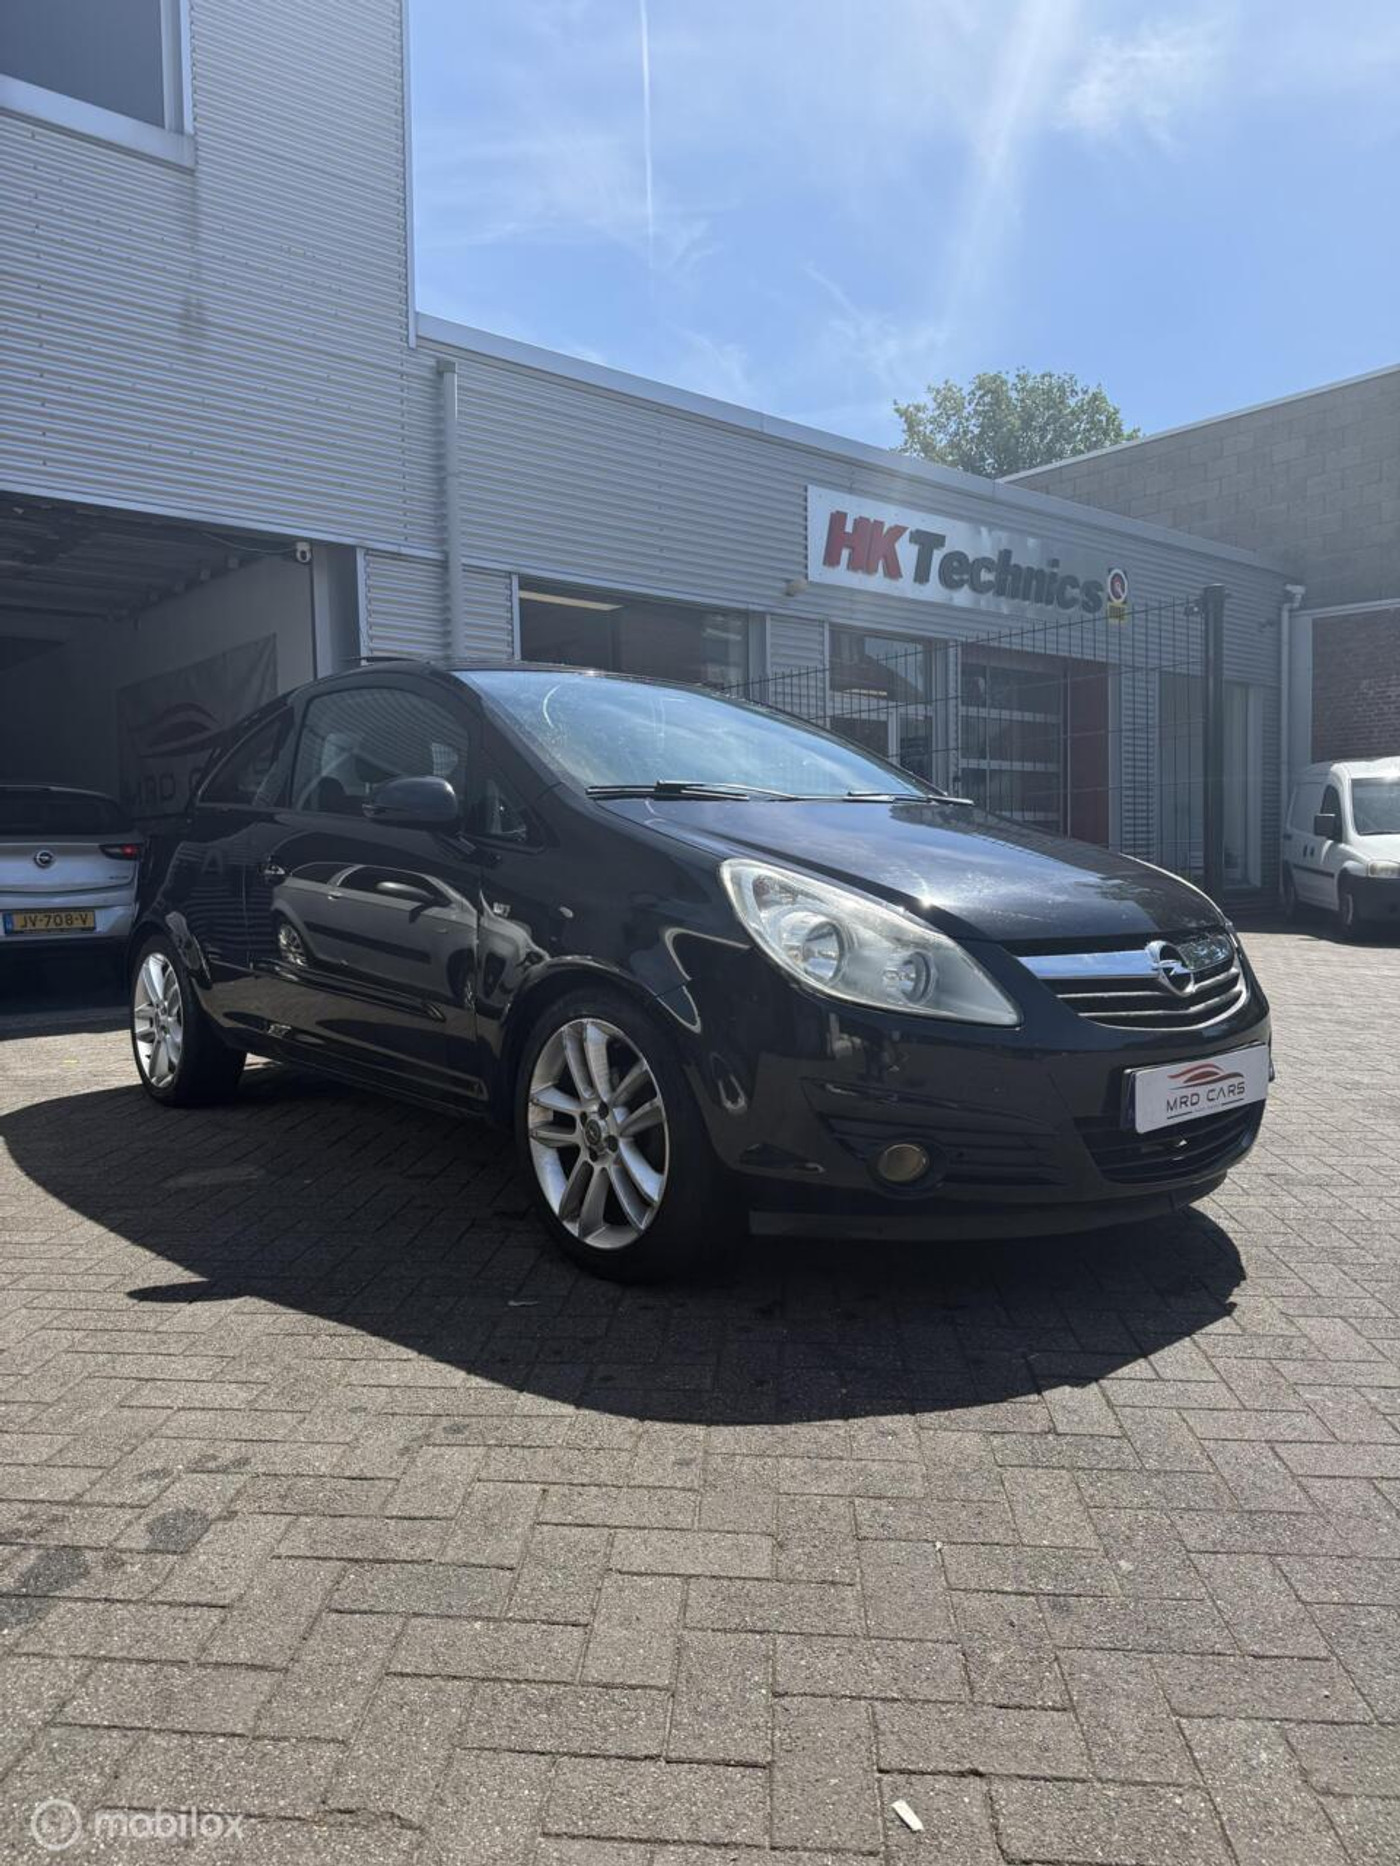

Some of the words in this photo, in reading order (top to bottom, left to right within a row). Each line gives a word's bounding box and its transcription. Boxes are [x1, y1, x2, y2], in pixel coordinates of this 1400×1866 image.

[822, 510, 909, 581] HK
[909, 528, 1104, 613] Technics
[1166, 1092, 1200, 1112] MRD
[1206, 1081, 1245, 1102] CARS
